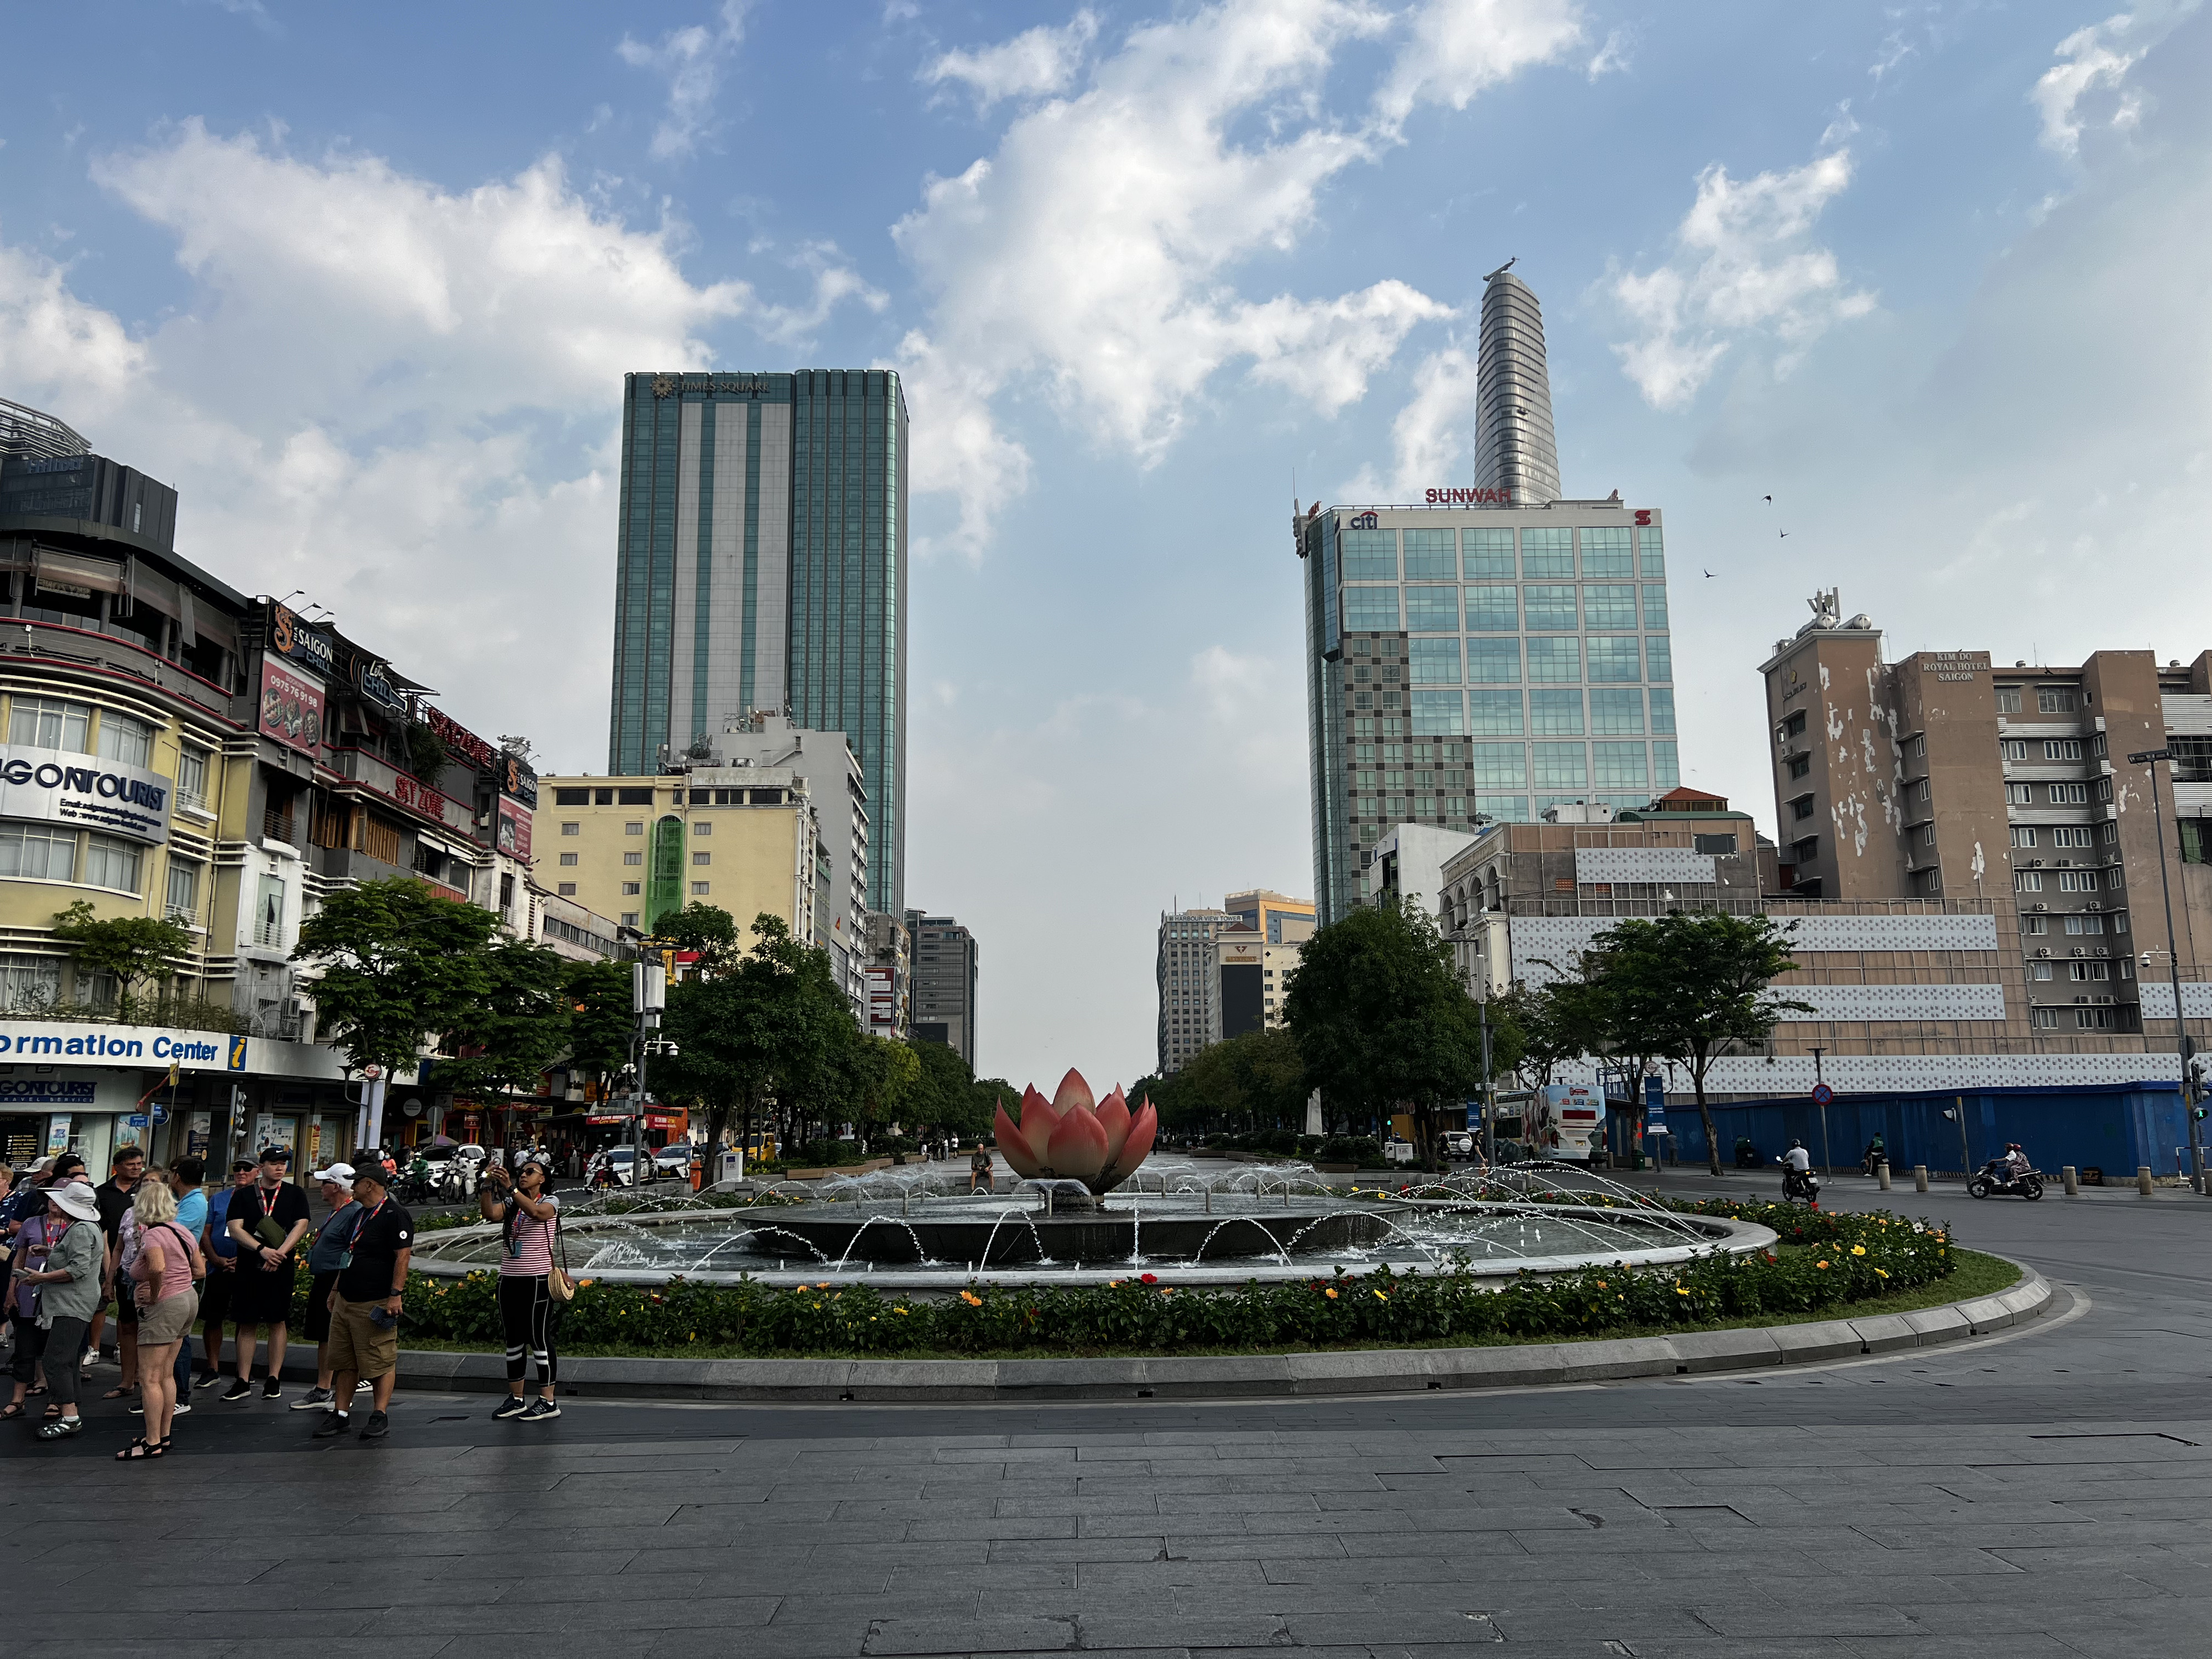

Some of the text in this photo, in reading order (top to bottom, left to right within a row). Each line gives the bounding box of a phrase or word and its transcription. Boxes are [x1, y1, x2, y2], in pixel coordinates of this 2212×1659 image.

[679, 382, 769, 393] TIMES SQUARE
[1425, 488, 1511, 503] SUNWAH
[1350, 513, 1378, 529] citi
[299, 629, 333, 663] SAIGON
[1936, 653, 1972, 661] KIM DO
[1923, 662, 1989, 672] ROYAL HOTEL
[1938, 672, 1974, 682] SAIGON
[270, 675, 317, 707] 0975 76 91 98
[364, 673, 394, 703] CHILL
[520, 774, 538, 793] SAIGON
[395, 775, 445, 820] SKY ZONE
[153, 1036, 218, 1061] Center
